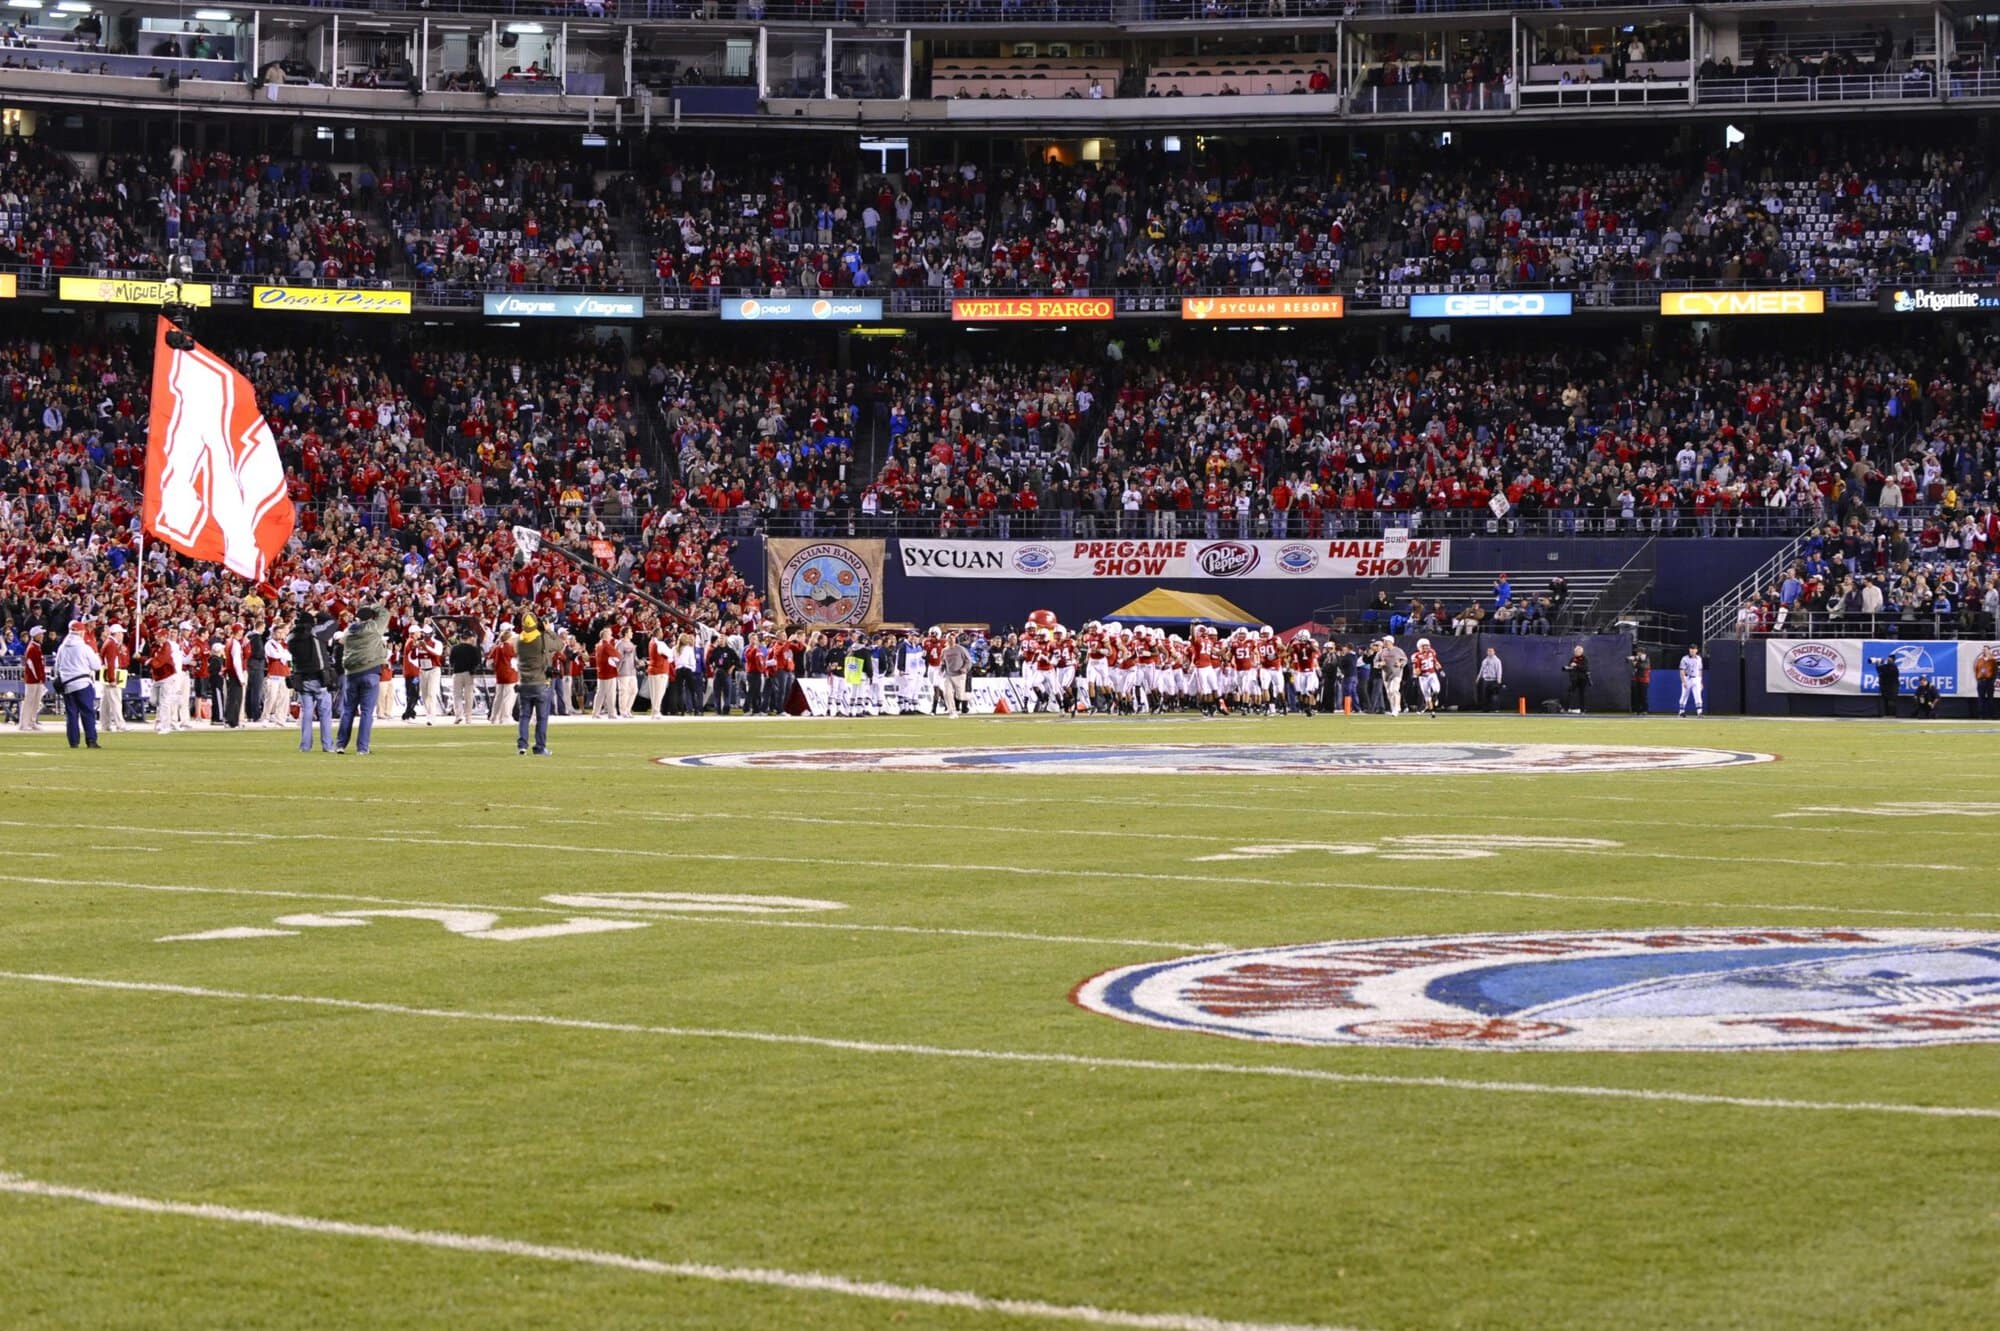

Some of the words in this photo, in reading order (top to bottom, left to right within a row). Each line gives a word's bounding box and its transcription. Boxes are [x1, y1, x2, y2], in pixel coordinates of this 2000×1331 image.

[509, 299, 557, 314] Degree
[587, 301, 634, 316] Degree
[1219, 303, 1276, 313] SYCUAN
[1283, 302, 1338, 312] RESORT
[1445, 295, 1545, 316] GEICO
[1679, 293, 1806, 315] CYMER
[1915, 289, 1979, 311] Brigantine
[761, 304, 791, 315] pepsi
[832, 304, 862, 315] pepsi
[958, 302, 1033, 317] WELLS
[1037, 302, 1110, 317] FARGO
[790, 546, 831, 570] SYCUAN
[833, 547, 862, 570] BAND
[904, 547, 1003, 569] SYCUAN
[1073, 541, 1187, 559] PREGAME
[1220, 547, 1238, 560] Dr
[1328, 541, 1441, 559] HALFME
[1092, 559, 1168, 577] SHOW
[1208, 550, 1248, 572] Pepper
[1355, 559, 1430, 577] SHOW
[853, 577, 870, 619] NATION
[1236, 647, 1250, 659] 51
[1863, 674, 1917, 690] PAFIC
